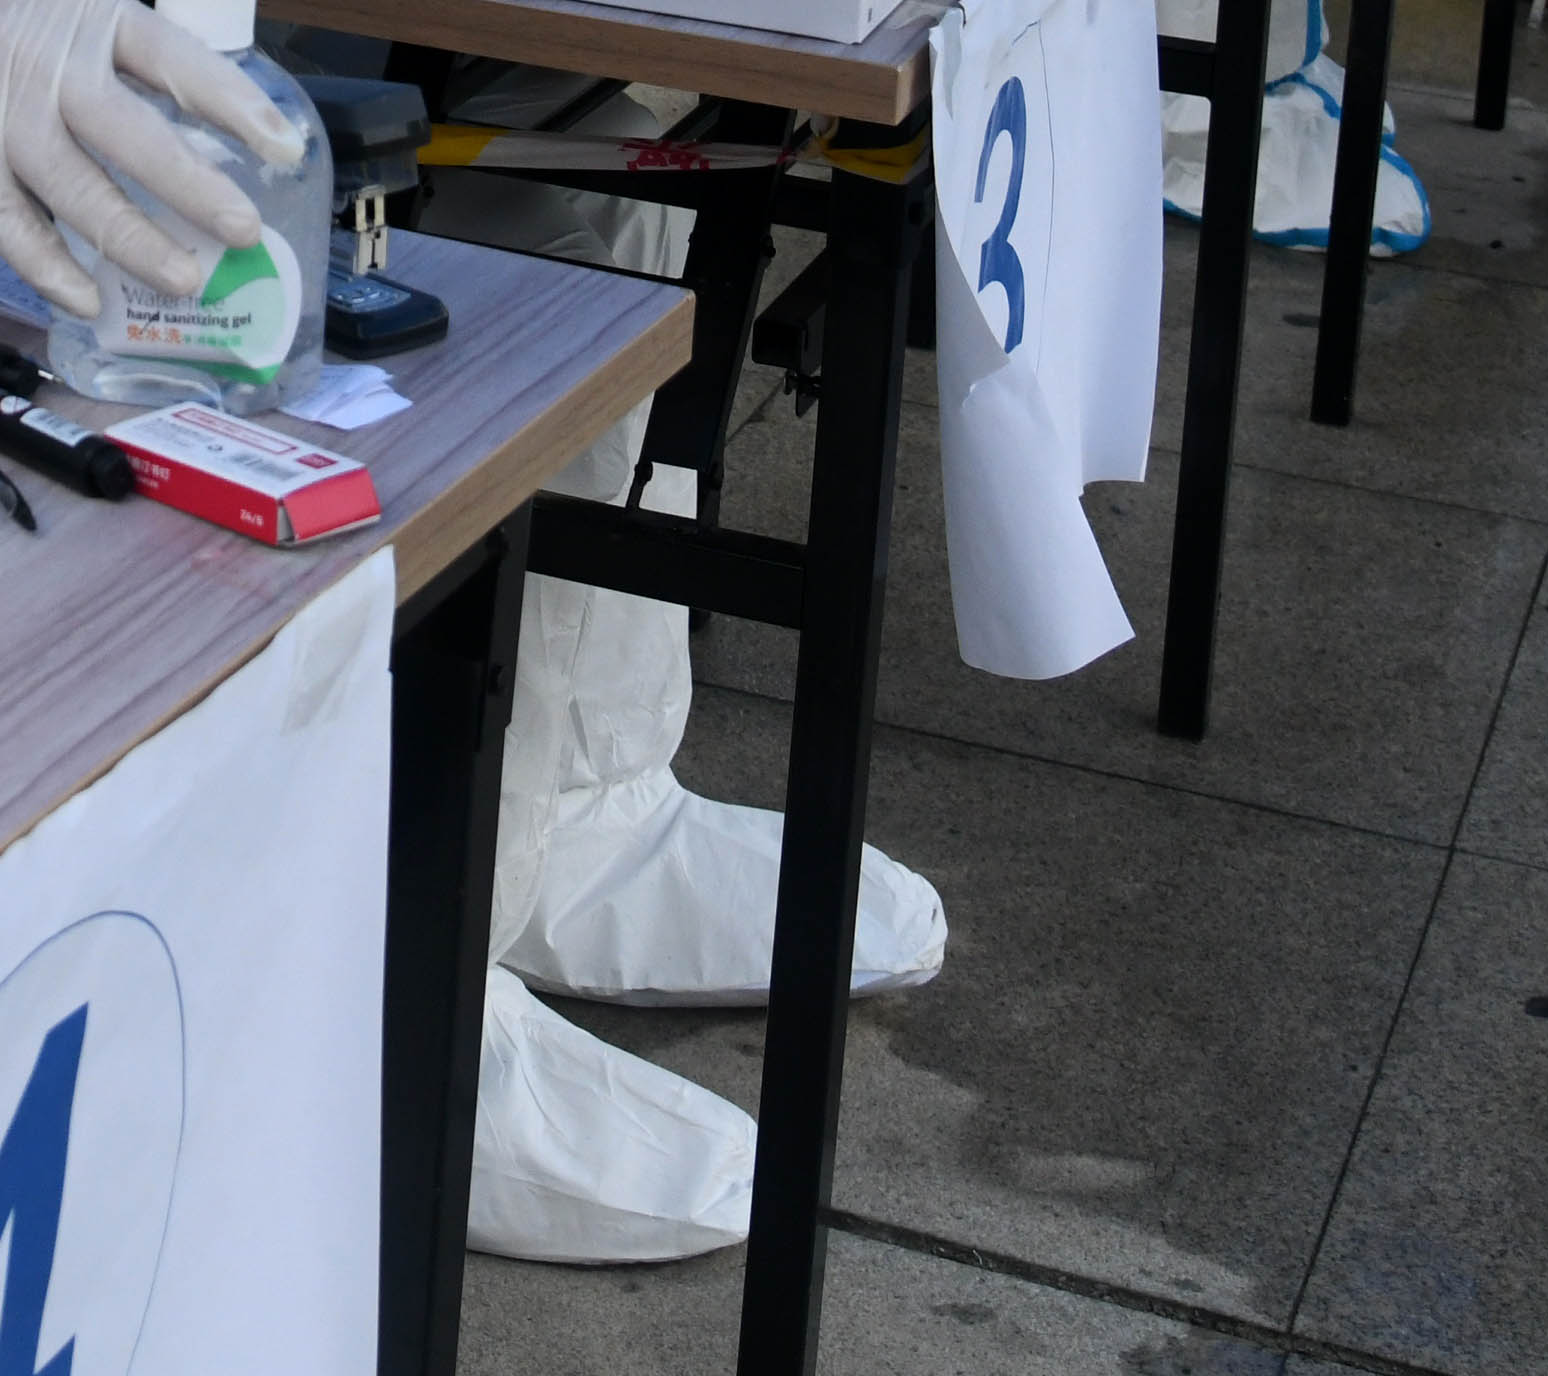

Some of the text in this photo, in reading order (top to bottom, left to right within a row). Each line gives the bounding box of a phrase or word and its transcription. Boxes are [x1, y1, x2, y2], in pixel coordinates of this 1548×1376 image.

[973, 75, 1027, 356] 3
[127, 308, 252, 329] hand sanitizing gel
